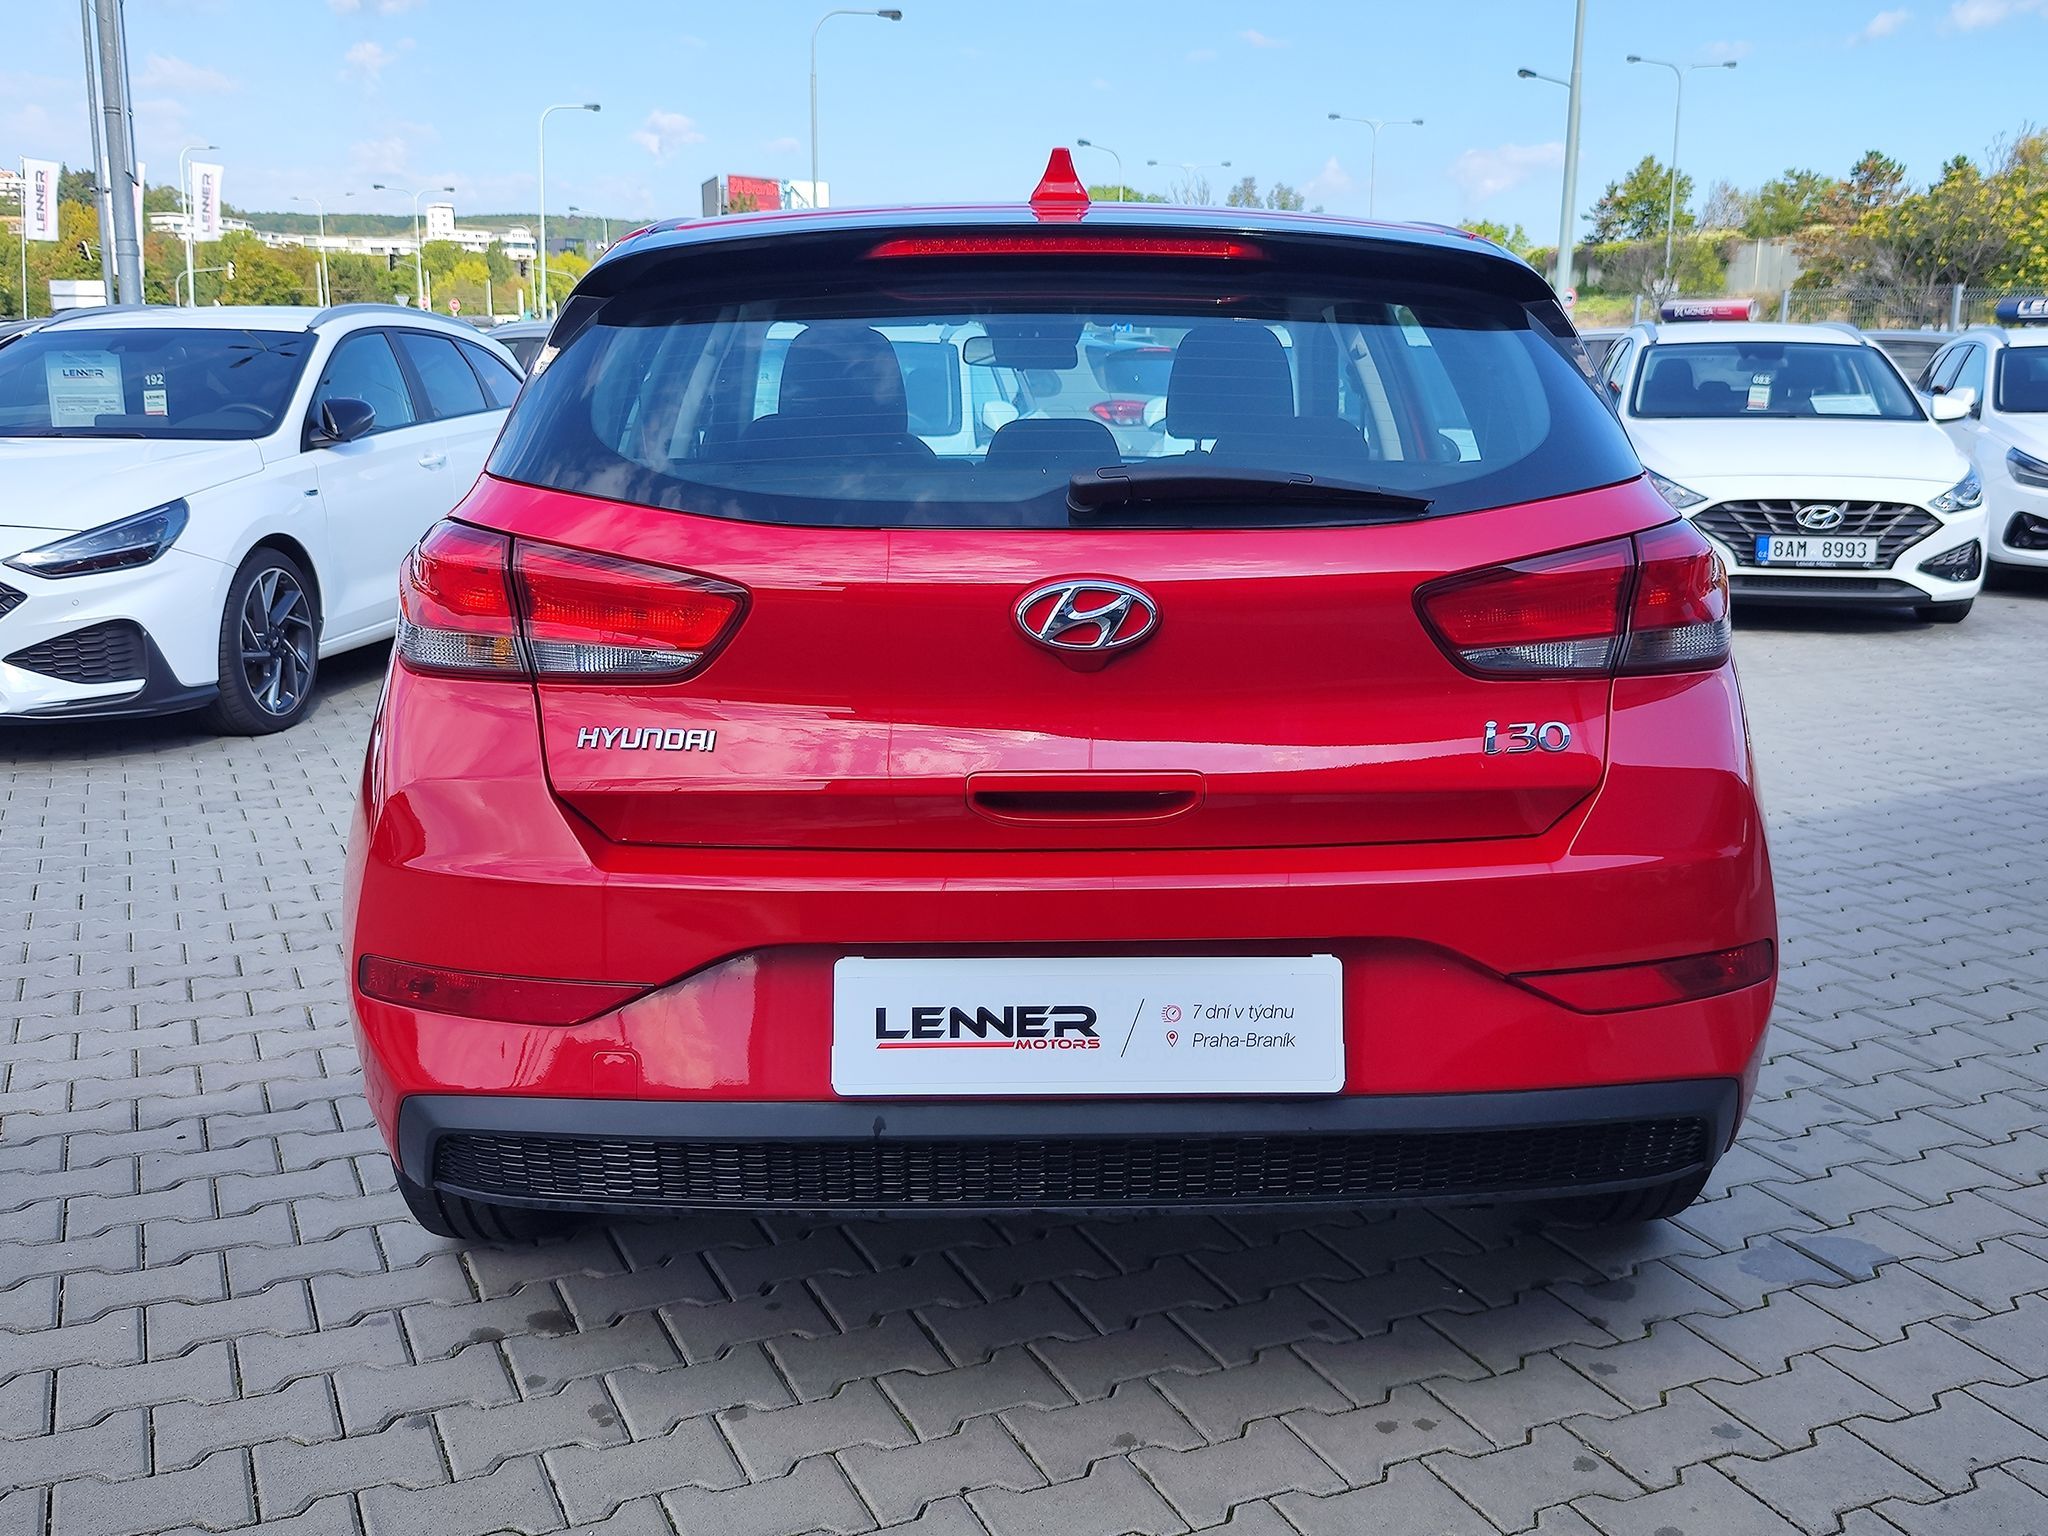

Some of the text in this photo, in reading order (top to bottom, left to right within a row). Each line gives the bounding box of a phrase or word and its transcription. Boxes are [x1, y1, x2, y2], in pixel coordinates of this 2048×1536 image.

[36, 170, 46, 232] LENNER
[202, 173, 212, 233] LENNER
[144, 373, 165, 386] 192
[1773, 540, 1868, 559] 8AM 8993
[576, 726, 717, 752] HYUNDAI
[875, 1005, 1101, 1040] LENNER
[1193, 1003, 1295, 1023] 7 dní v týdnu
[1015, 1038, 1101, 1050] MOTORS
[1192, 1031, 1297, 1048] Praha-Braník
